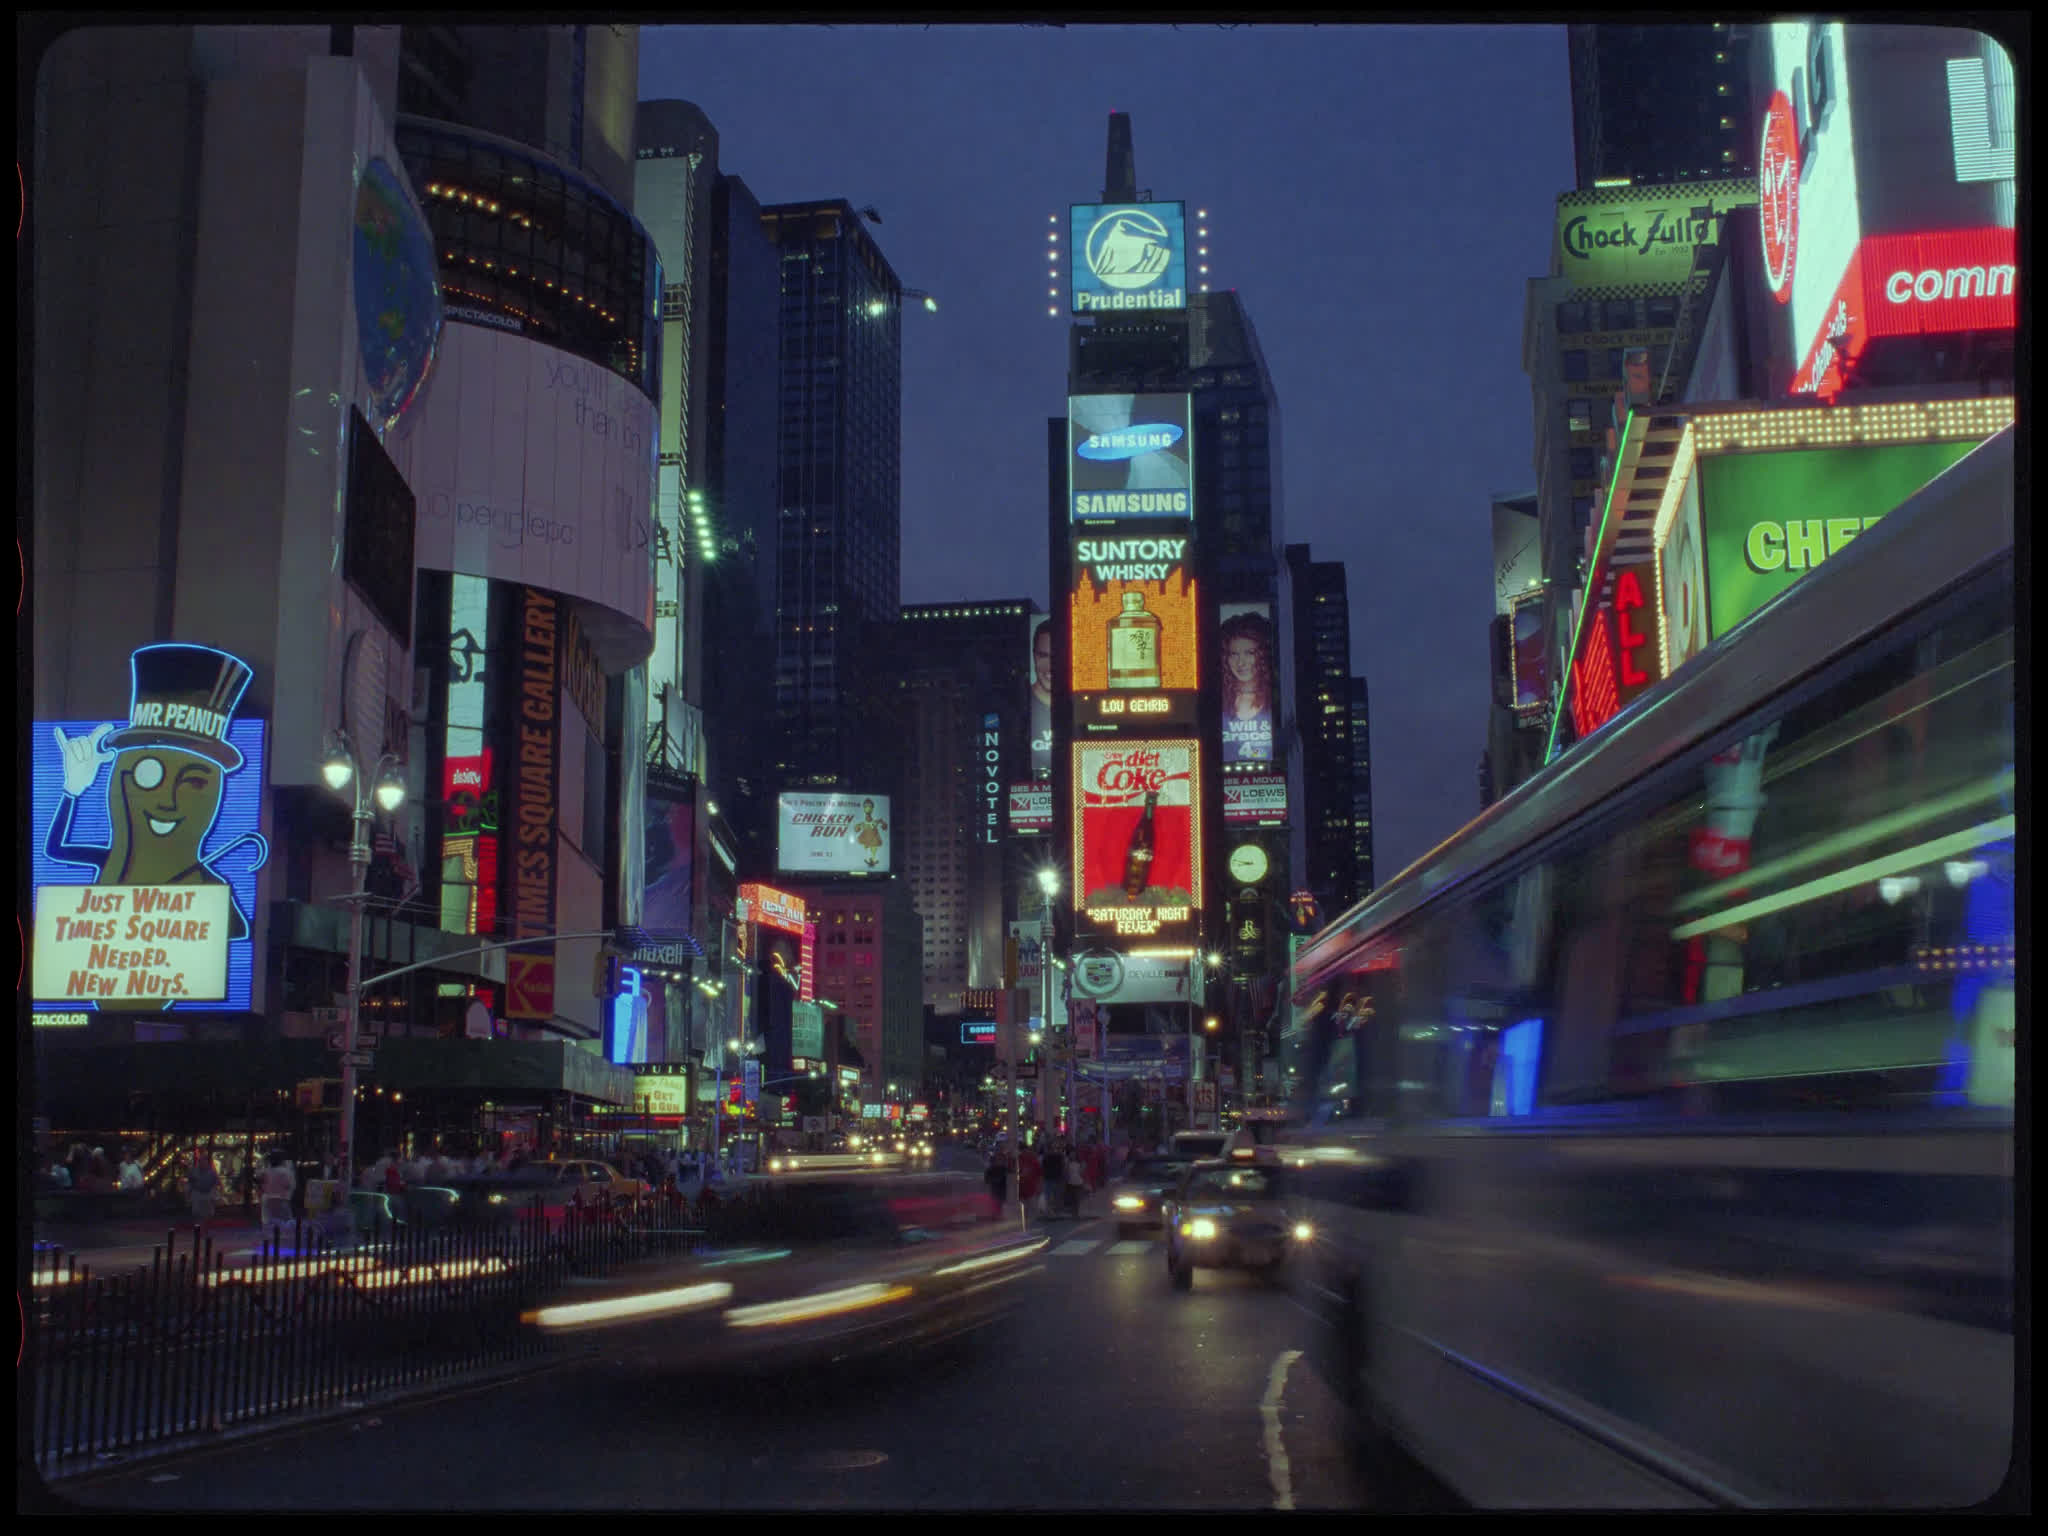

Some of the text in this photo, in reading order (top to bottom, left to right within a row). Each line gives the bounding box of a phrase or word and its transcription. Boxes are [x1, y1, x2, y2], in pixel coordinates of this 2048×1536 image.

[1563, 215, 1639, 259] Chock
[1638, 213, 1691, 255] full
[1077, 288, 1181, 310] Prudential
[1088, 433, 1173, 449] SAMSUNG
[1076, 492, 1187, 514] SAMSUNG
[1077, 539, 1186, 562] SUNTORY
[1746, 516, 1881, 570] CHE
[1096, 564, 1169, 581] WHISKY
[1102, 698, 1169, 713] LOU GEHRIG
[134, 703, 227, 739] MR. PEANUT
[1229, 720, 1257, 732] Will
[516, 585, 557, 938] TIMES SQUARE GALLERY
[1126, 749, 1160, 767] diet
[1097, 761, 1167, 791] Coke
[1253, 776, 1285, 784] MOVIE
[984, 732, 999, 843] NOVOTEL
[1242, 789, 1285, 798] LOEWS
[791, 813, 854, 823] CHICKEN
[810, 826, 848, 838] RUN
[76, 888, 196, 914] JUST WHAT
[1157, 906, 1189, 921] NIGHT
[55, 916, 210, 941] TIMES SQUARE
[88, 945, 171, 970] NEEDED.
[632, 943, 683, 966] maxell
[67, 971, 189, 996] NEW NUTS.
